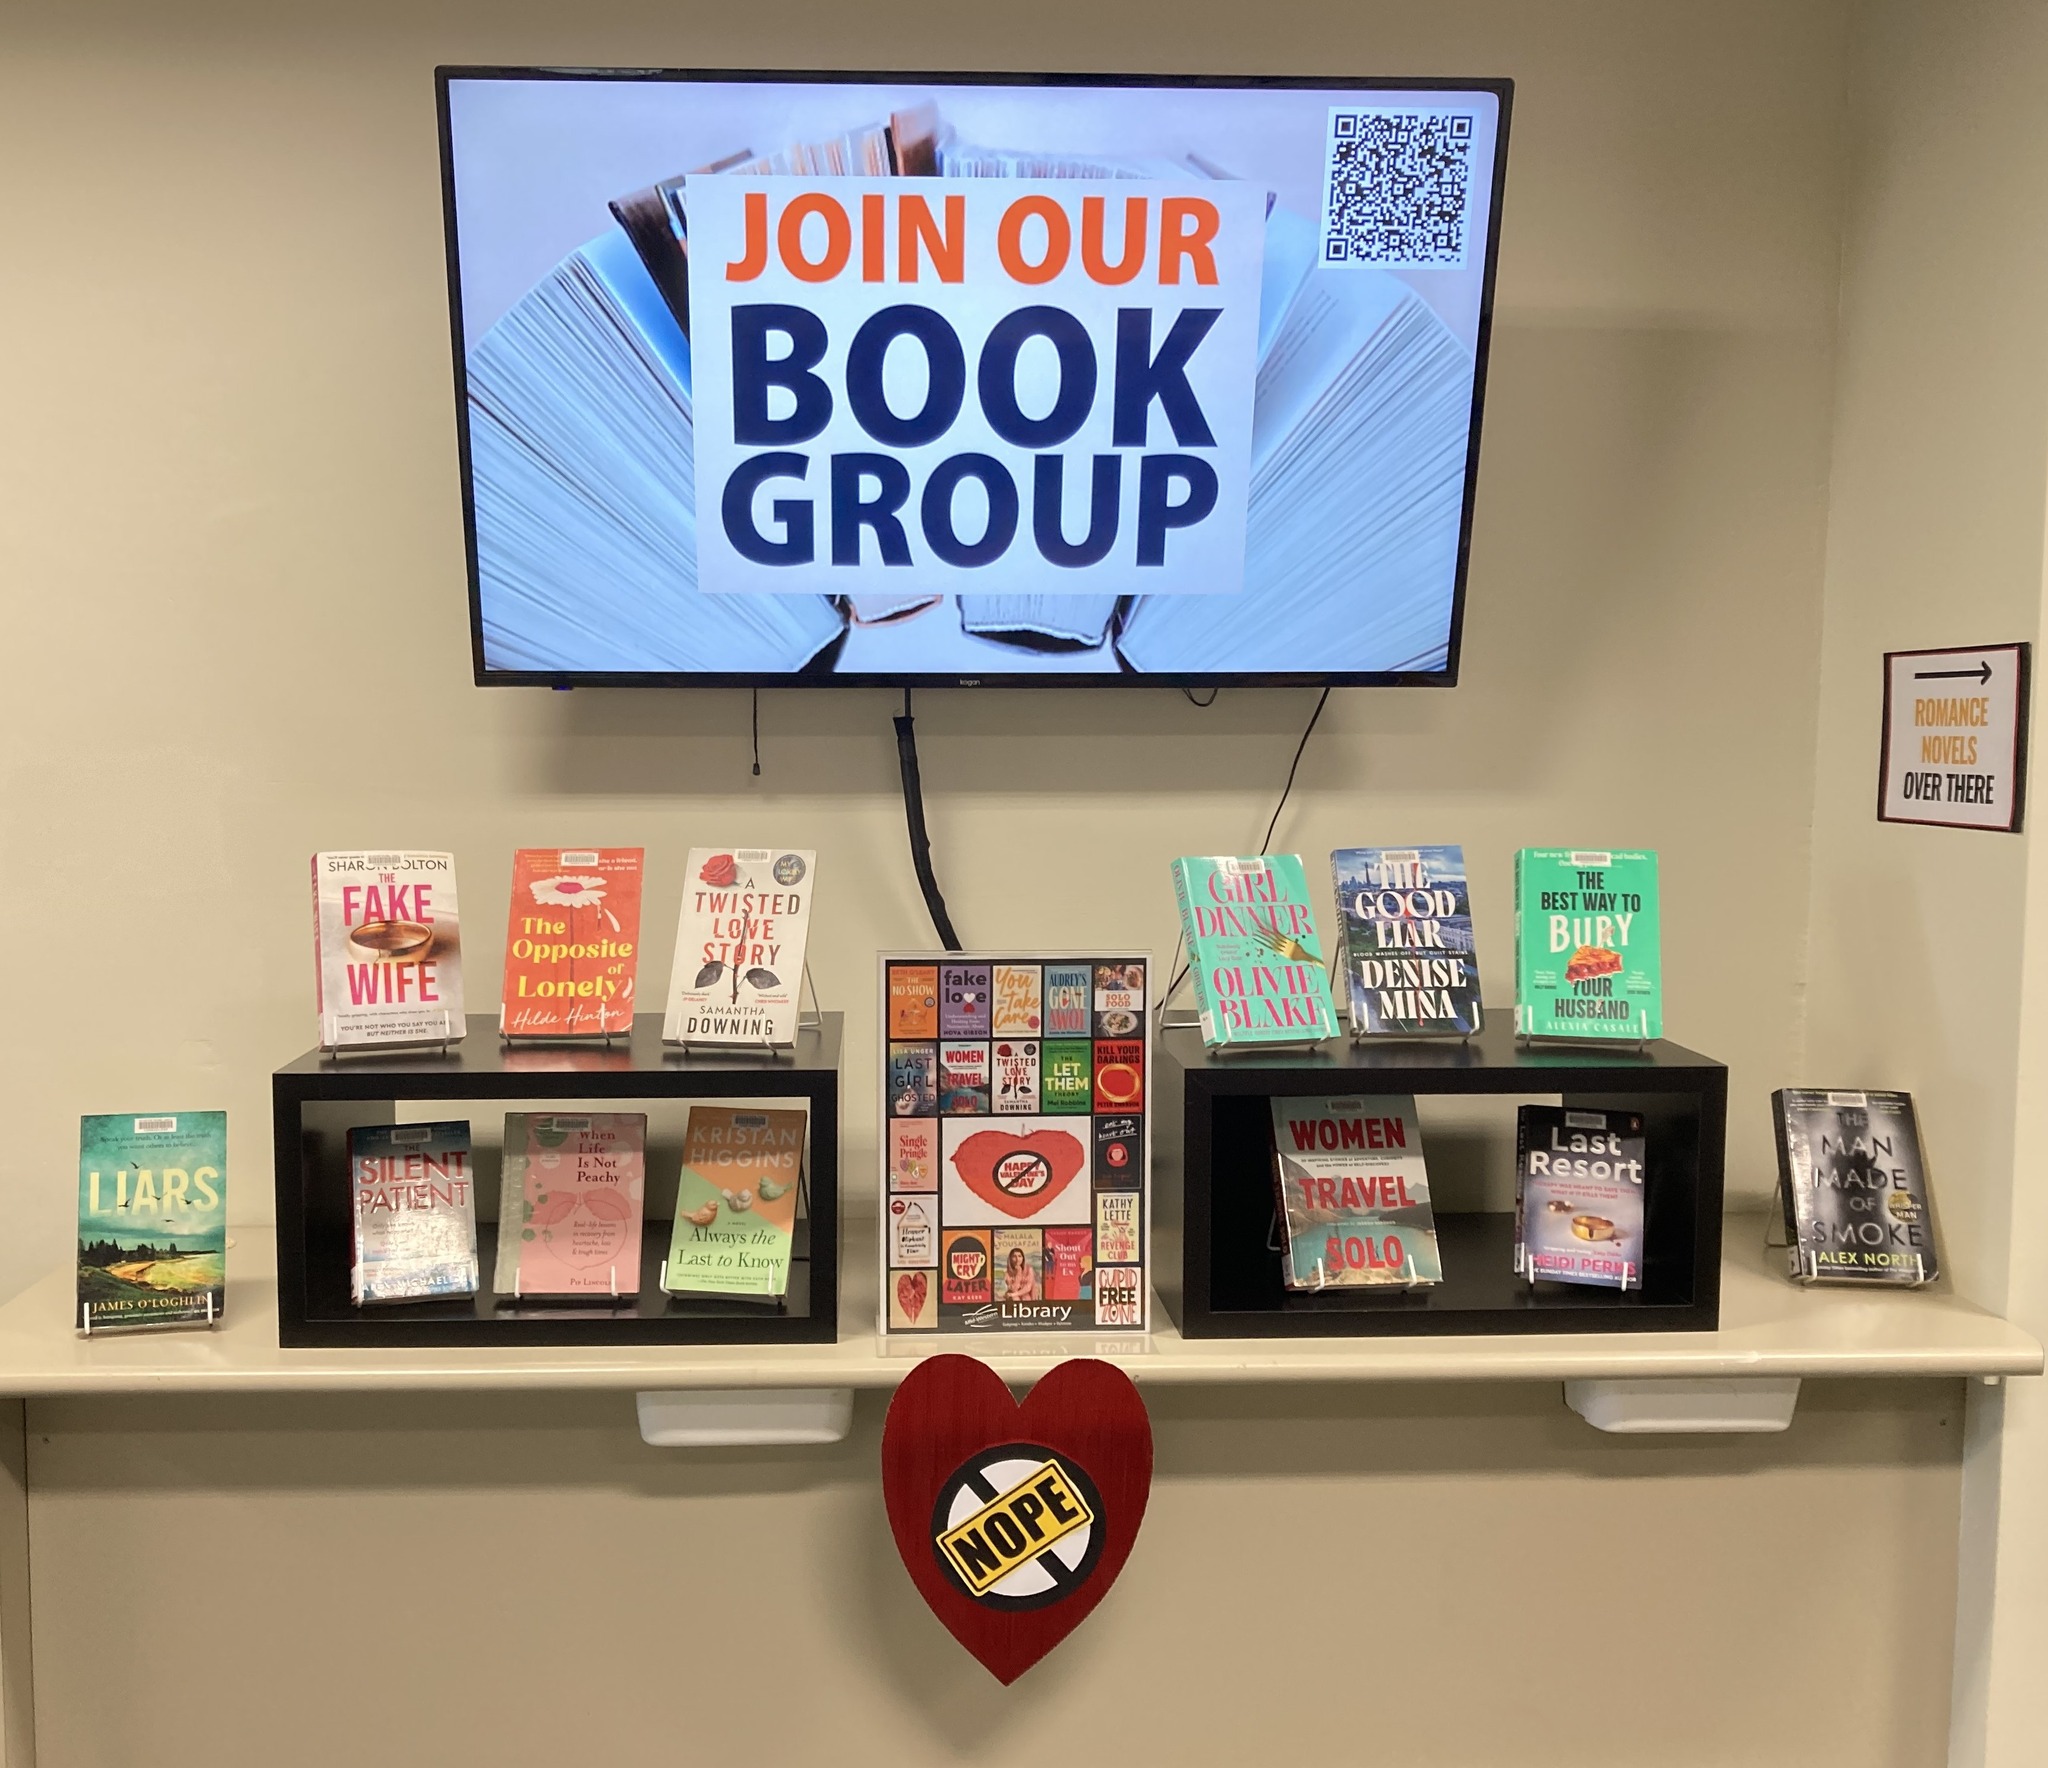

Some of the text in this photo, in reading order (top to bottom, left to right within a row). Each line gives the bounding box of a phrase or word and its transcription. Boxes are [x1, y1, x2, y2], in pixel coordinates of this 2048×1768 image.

[725, 193, 1220, 286] JOIN OUR
[731, 304, 1224, 448] BOOK
[721, 451, 1219, 568] GROUP
[959, 678, 981, 688] kogan
[1915, 697, 1989, 727] ROMANCE
[1921, 735, 1977, 765] NOVELS
[1903, 771, 1995, 804] OVER THERE
[378, 873, 396, 883] THE
[745, 878, 755, 889] A
[1373, 862, 1431, 890] THE
[1576, 871, 1605, 890] THE
[1208, 869, 1288, 904] GIRL
[343, 884, 434, 926] FAKE
[695, 892, 801, 915] TWISTED
[1354, 890, 1456, 920] GOOD
[1541, 892, 1641, 912] BEST WAY TO
[521, 917, 566, 935] The
[713, 918, 774, 940] LOVE
[1194, 904, 1313, 938] DINNER
[1375, 920, 1447, 949] LIAR
[1549, 913, 1633, 953] BURY
[512, 938, 633, 964] Opposite
[702, 942, 781, 966] STORY
[607, 963, 624, 975] of
[944, 970, 987, 986] fake
[1360, 958, 1467, 989] DENISE
[347, 961, 439, 1005] WIFE
[518, 975, 623, 1002] Lonely
[907, 976, 919, 984] THE
[995, 967, 1034, 995] You
[1050, 973, 1087, 986] AUDREY'S
[1213, 964, 1320, 998] OLIVIE
[1573, 978, 1613, 997] YOUR
[1002, 989, 1040, 1012] Take
[1048, 986, 1087, 1010] GONE
[1379, 990, 1458, 1019] MINA
[700, 1005, 766, 1016] SAMANTHA
[994, 1006, 1029, 1029] Care
[1218, 996, 1326, 1030] BLAKE
[1554, 998, 1630, 1020] HUSBAND
[341, 1024, 363, 1032] YOU'RE
[511, 1008, 561, 1030] Hilde
[687, 1017, 774, 1035] DOWNING
[1049, 1009, 1085, 1030] AWOL
[1546, 1021, 1640, 1033] ALEXIA CASALE
[945, 1050, 984, 1063] WOMEN
[1097, 1046, 1115, 1055] KILL
[1117, 1046, 1140, 1055] YOUR
[1097, 1055, 1140, 1064] DARLINGS
[895, 1058, 932, 1070] LAST
[997, 1058, 1036, 1067] TWISTED
[1005, 1067, 1028, 1076] LOVE
[1053, 1063, 1081, 1076] LET
[895, 1071, 933, 1088] GIRL
[945, 1073, 985, 1086] TRAVEL
[1002, 1077, 1031, 1085] STORY
[1045, 1077, 1089, 1091] THEM
[891, 1093, 935, 1103] GHOSTED
[950, 1095, 978, 1109] SOLO
[1836, 1112, 1869, 1127] THE
[579, 1130, 616, 1140] When
[693, 1126, 797, 1146] KRISTAN
[900, 1134, 928, 1149] Single
[1289, 1117, 1406, 1151] WOMEN
[1552, 1127, 1622, 1157] Last
[578, 1143, 605, 1154] Life
[900, 1148, 928, 1160] Pringle
[1822, 1135, 1894, 1157] MAN
[577, 1157, 617, 1169] Is Not
[690, 1148, 794, 1168] HIGGINS
[1530, 1151, 1642, 1184] Resort
[358, 1151, 468, 1185] SILENT
[576, 1171, 621, 1186] Peachy
[1814, 1167, 1908, 1190] MADE
[89, 1166, 220, 1216] LIARS
[359, 1181, 470, 1214] PATIENT
[1298, 1176, 1417, 1210] TRAVEL
[1102, 1198, 1133, 1209] KATHY
[1849, 1197, 1878, 1212] OF
[1104, 1209, 1131, 1221] LETTE
[1896, 1211, 1918, 1220] MAN
[689, 1227, 776, 1248] Always the
[1812, 1221, 1924, 1247] SMOKE
[1055, 1243, 1082, 1252] Shout
[1100, 1241, 1135, 1250] REVENGE
[1326, 1235, 1404, 1271] SOLO
[676, 1249, 785, 1269] Last to Know
[952, 1253, 981, 1264] MIGHT
[1059, 1252, 1077, 1261] Out
[1107, 1251, 1128, 1260] CLUB
[1533, 1254, 1575, 1270] HEIDI
[1818, 1251, 1918, 1266] ALEX NORTH
[956, 1264, 979, 1277] CRY
[1062, 1268, 1074, 1276] Ex
[1099, 1268, 1138, 1288] CUPID
[946, 1279, 989, 1293] LATER
[92, 1295, 209, 1313] JAMES O'LOGHLIN
[1099, 1287, 1136, 1307] FREE
[1001, 1303, 1072, 1321] Library
[1100, 1304, 1137, 1324] ZONE
[951, 1475, 1080, 1582] NOPE
